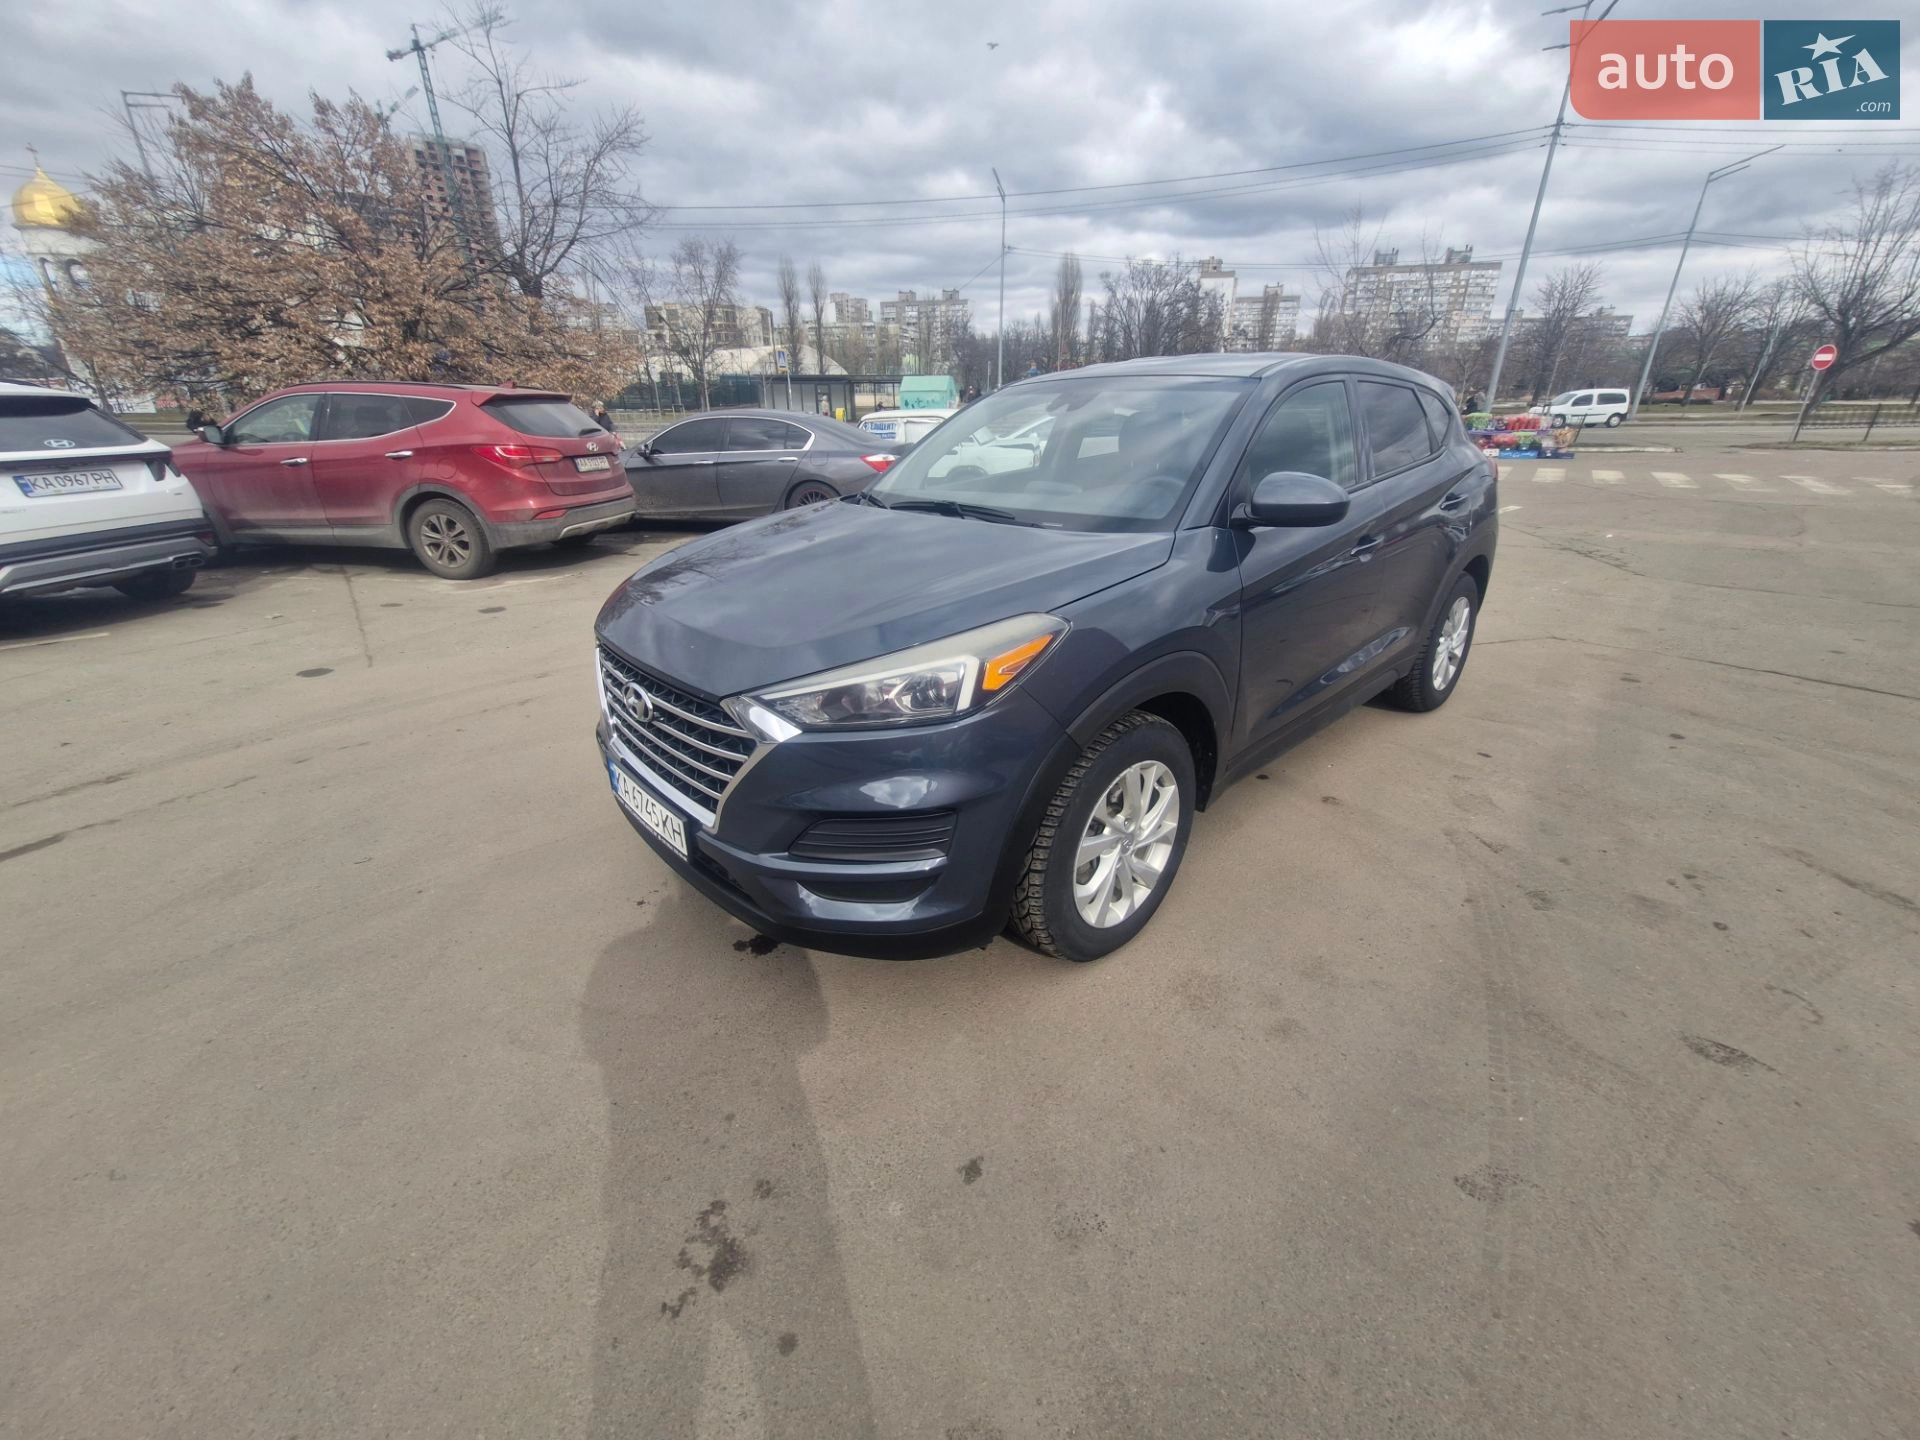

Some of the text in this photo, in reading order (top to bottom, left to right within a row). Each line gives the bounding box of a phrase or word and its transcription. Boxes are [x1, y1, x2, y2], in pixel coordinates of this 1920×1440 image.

[27, 471, 117, 491] KA 0967 PH
[632, 786, 660, 828] 6745
[660, 809, 684, 849] KH
